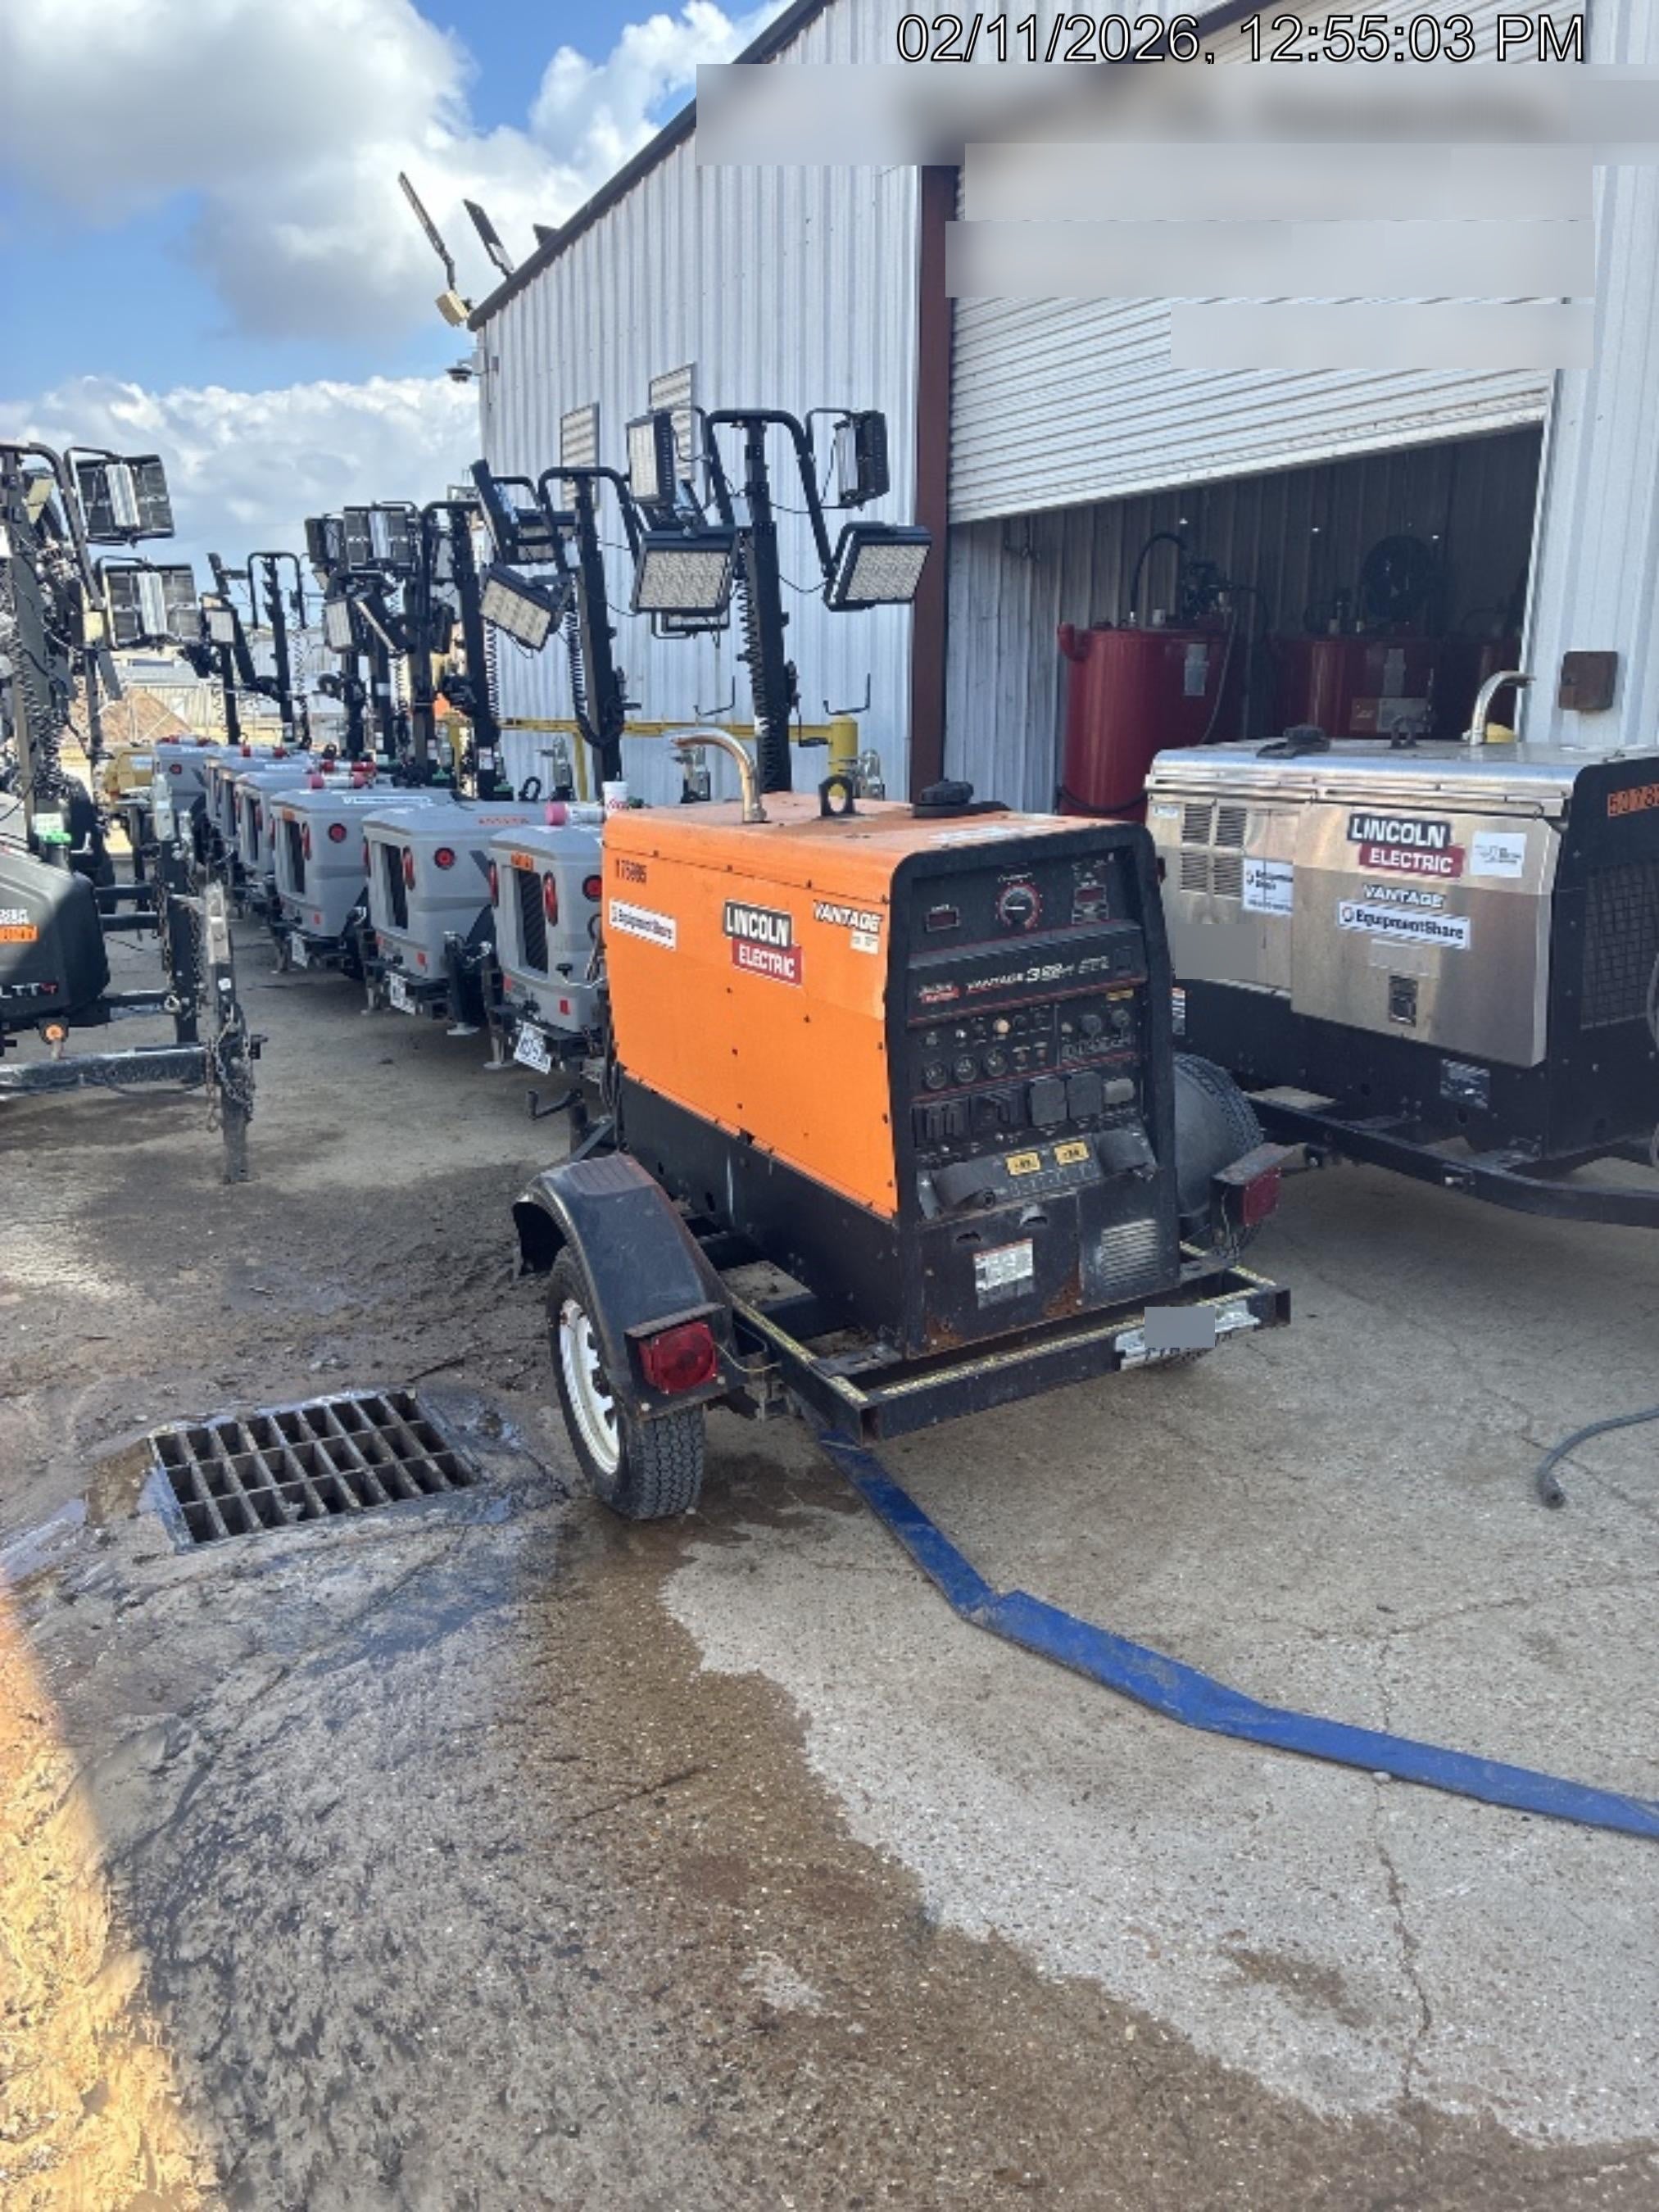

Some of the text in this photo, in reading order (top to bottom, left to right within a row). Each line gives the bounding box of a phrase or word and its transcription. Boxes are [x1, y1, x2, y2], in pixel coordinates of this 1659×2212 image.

[1353, 817, 1446, 849] LINCOLN
[1369, 847, 1453, 873] ELECTRIC
[1363, 883, 1444, 909] VANTAGE
[726, 906, 790, 947] LINCOLN
[813, 901, 882, 933] VANTAGE
[1356, 909, 1464, 940] EquipmentShare
[739, 943, 795, 979] ELECTRIC
